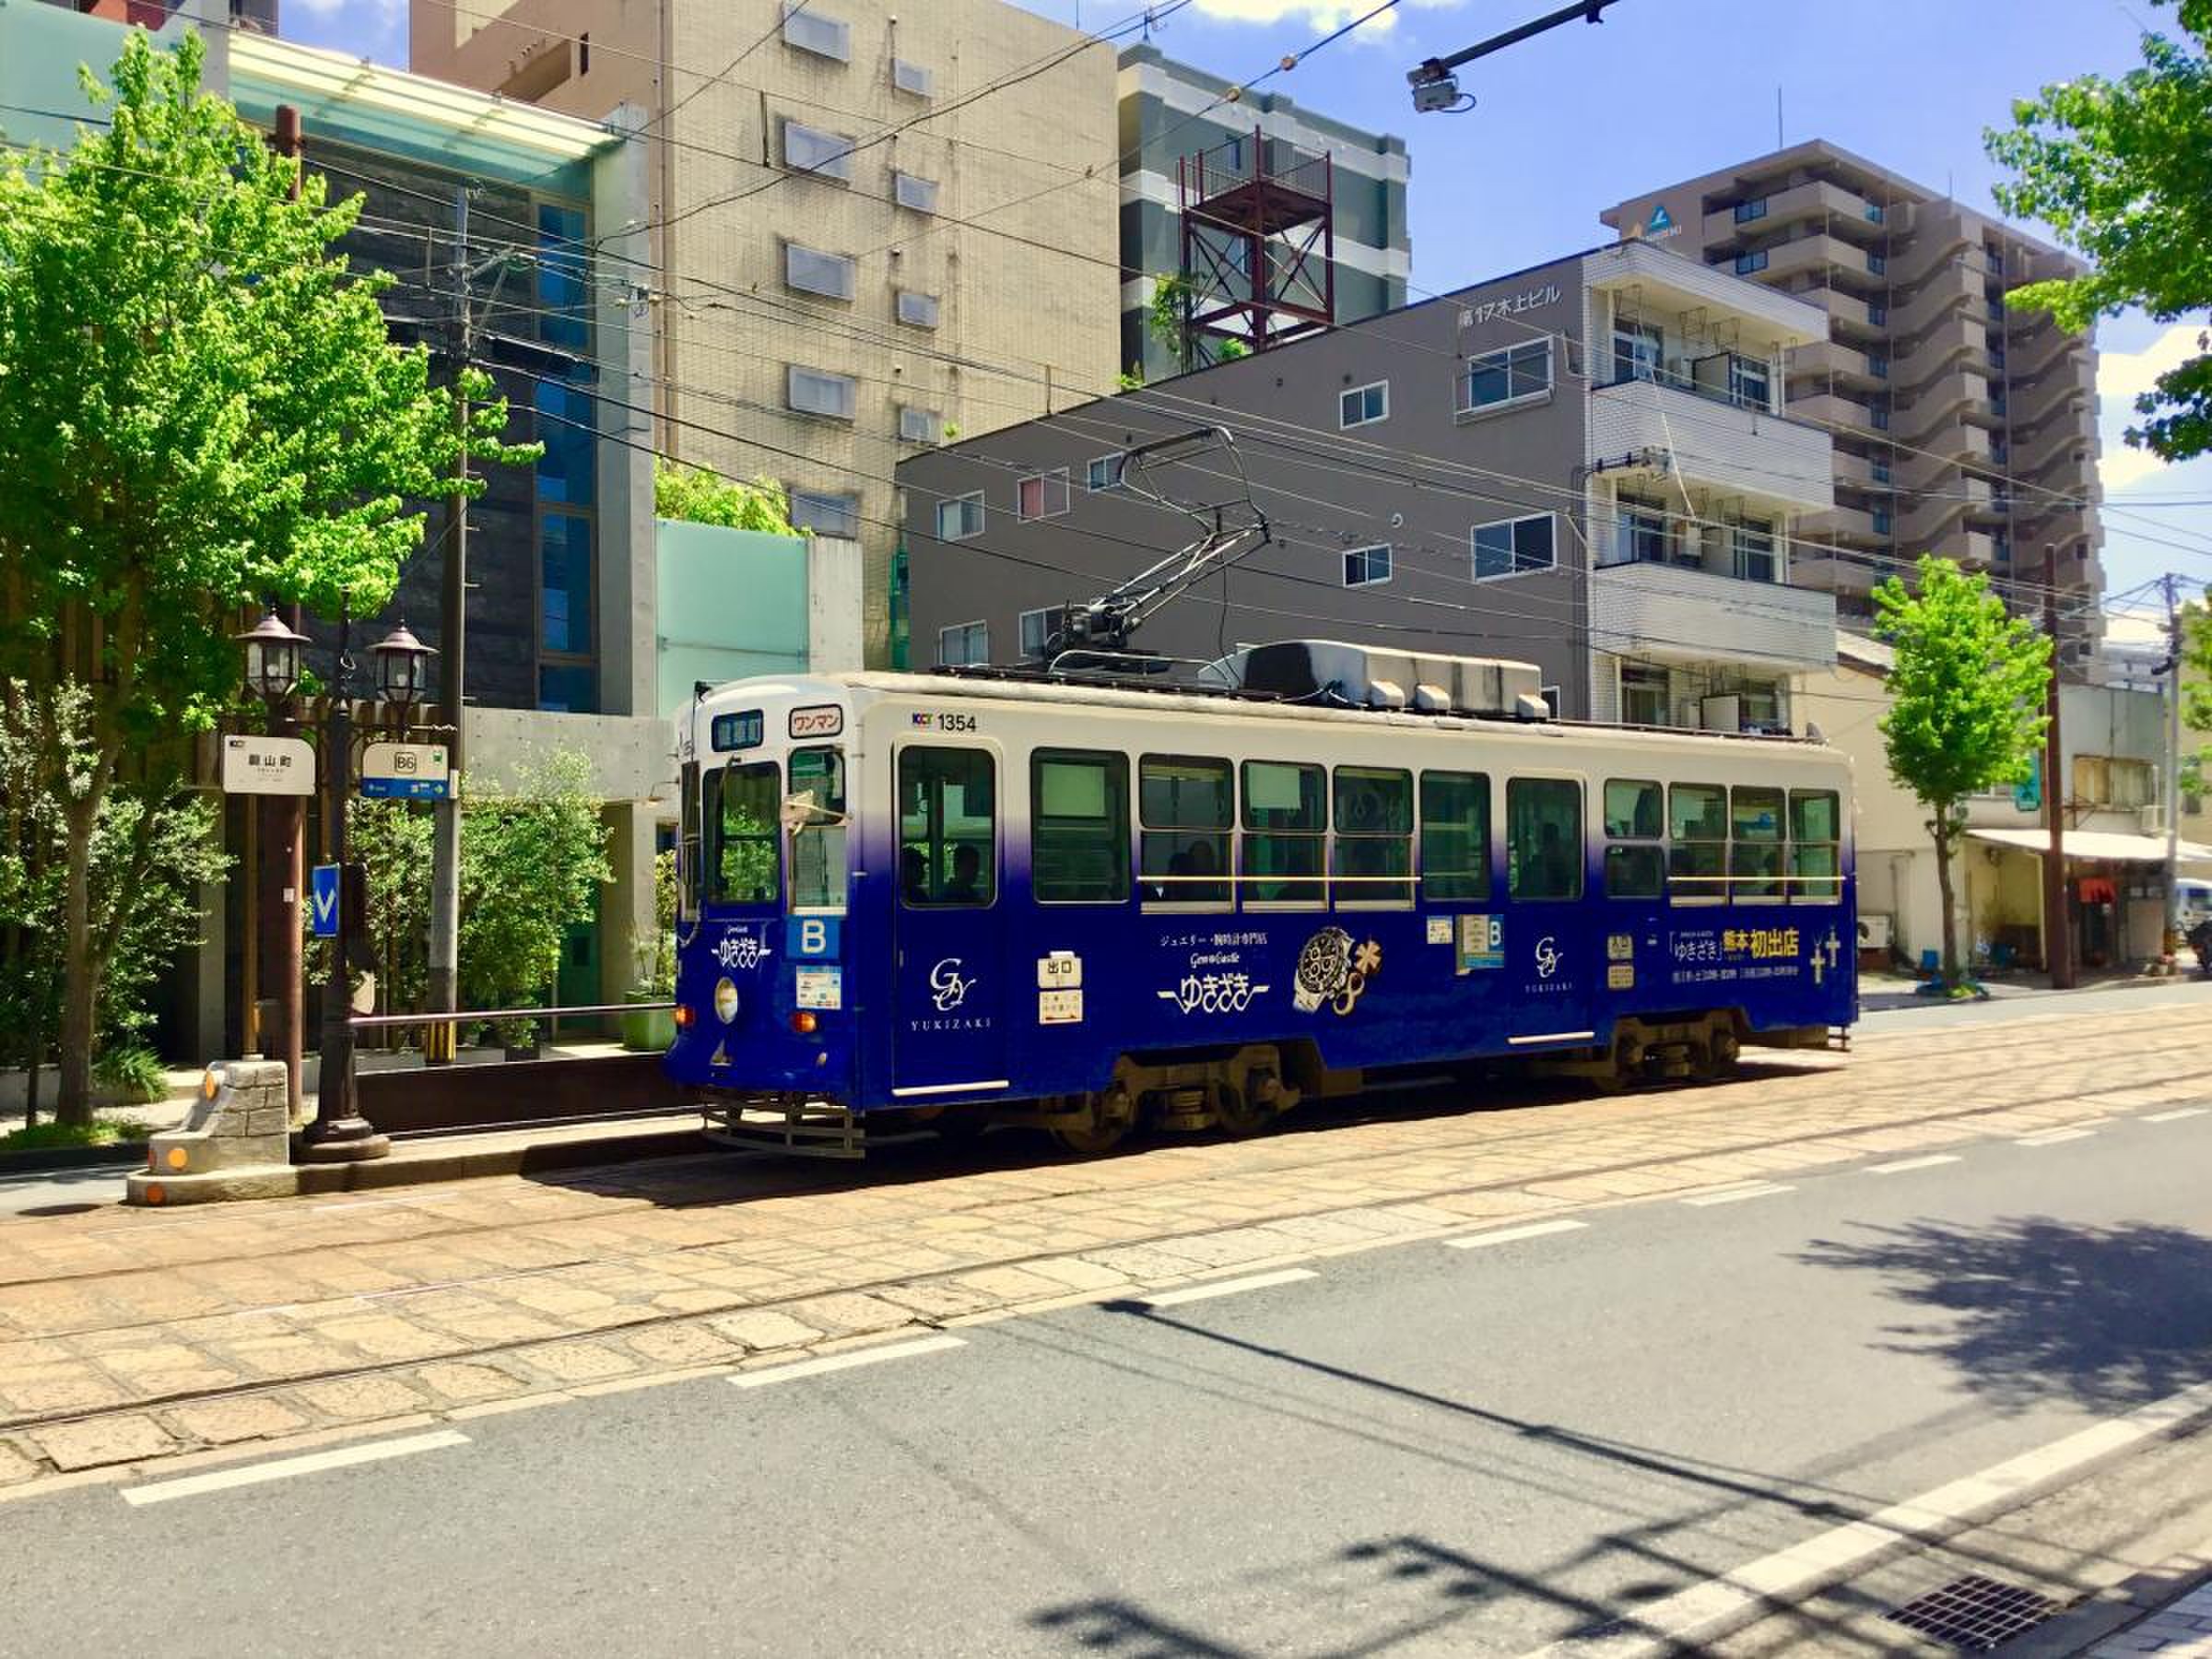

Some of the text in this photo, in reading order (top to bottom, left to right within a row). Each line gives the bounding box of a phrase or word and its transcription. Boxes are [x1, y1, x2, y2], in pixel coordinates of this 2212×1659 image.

[794, 714, 839, 731] ワンマン
[938, 713, 977, 732] 1354
[397, 756, 414, 769] B6
[802, 920, 827, 954] B
[1490, 922, 1501, 947] B
[1723, 927, 1799, 959] 熊本初出店
[1047, 959, 1073, 974] 出口
[1157, 973, 1270, 1014] ゆきざき
[911, 1018, 991, 1031] YUKIZAKI
